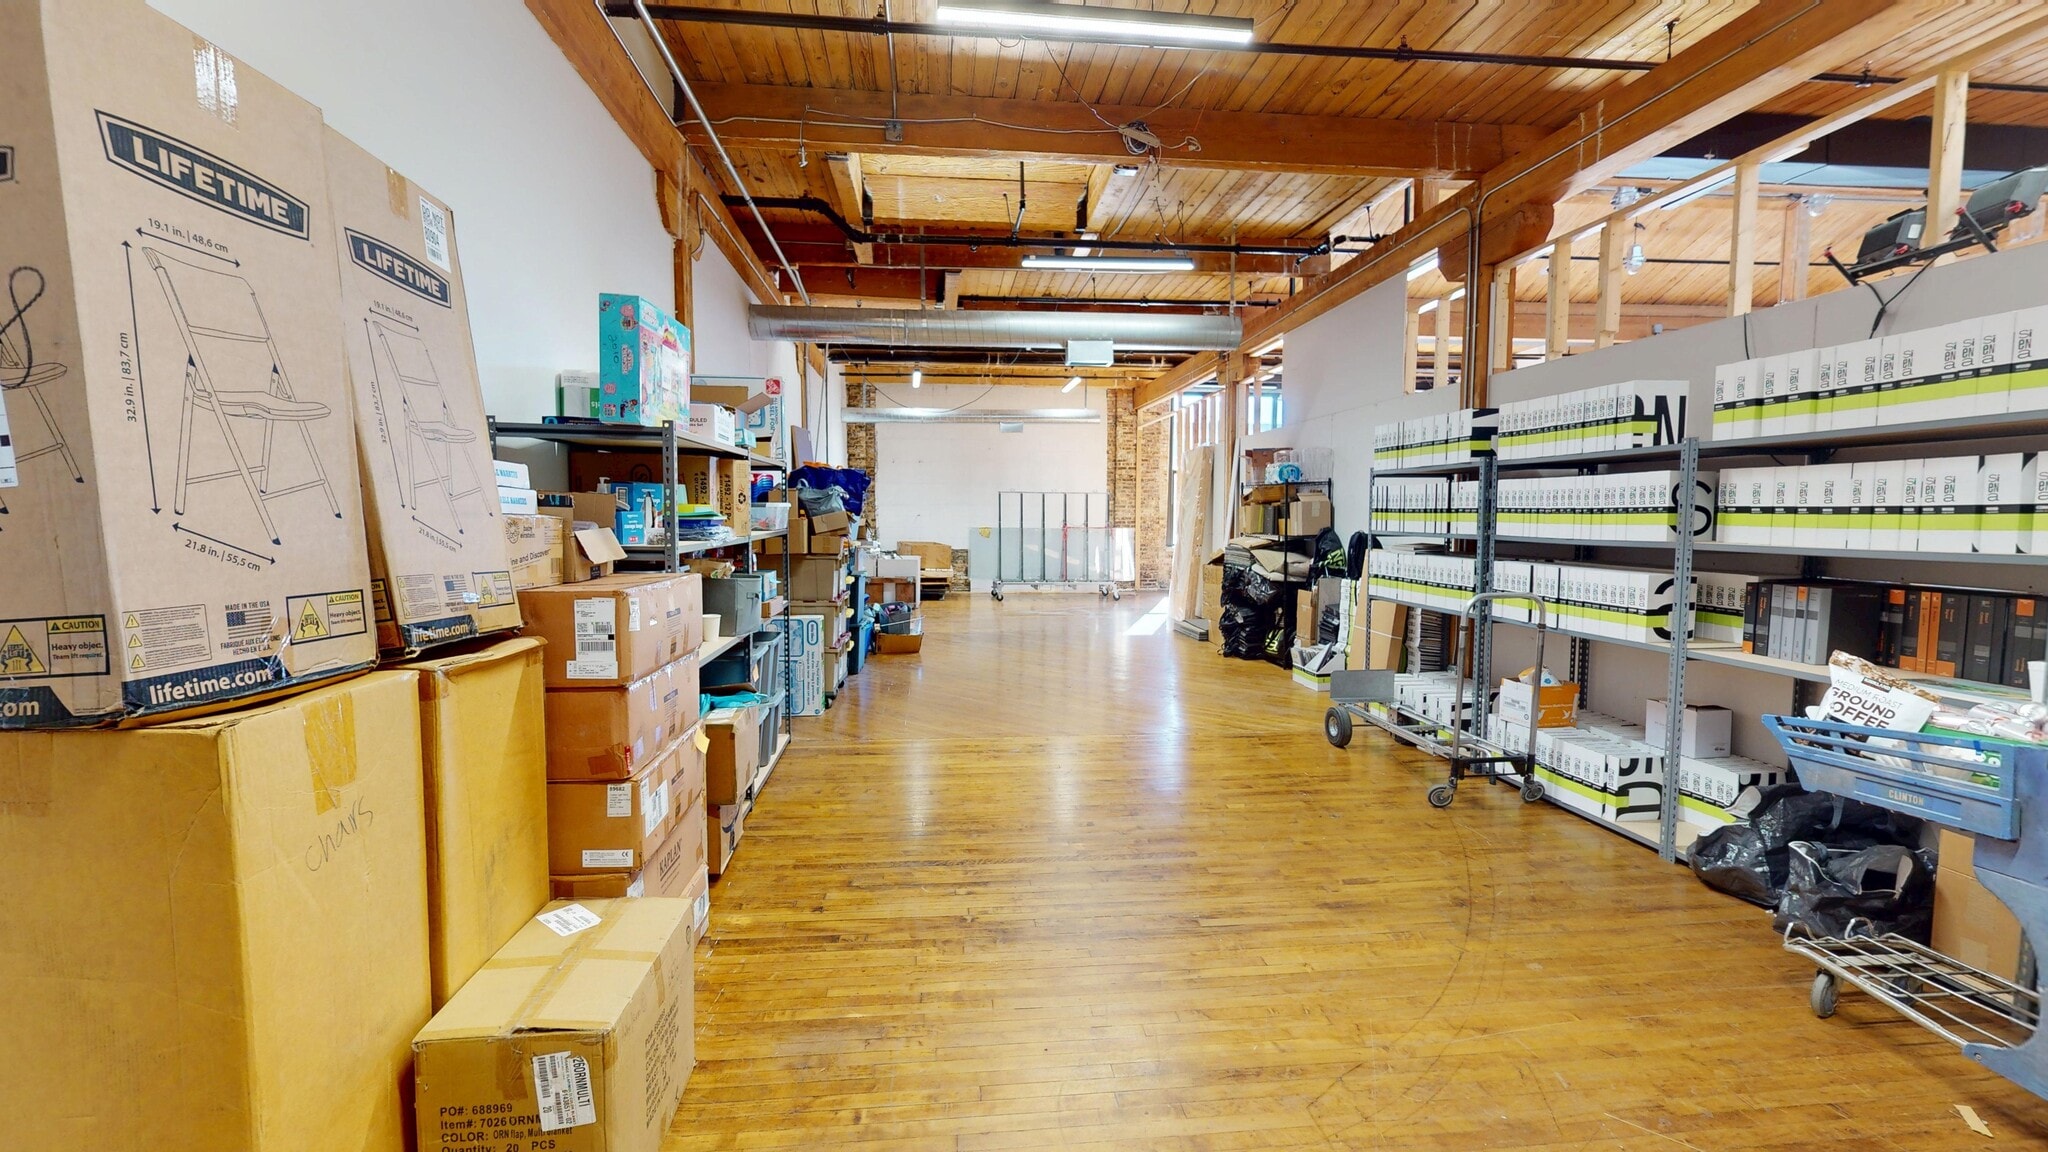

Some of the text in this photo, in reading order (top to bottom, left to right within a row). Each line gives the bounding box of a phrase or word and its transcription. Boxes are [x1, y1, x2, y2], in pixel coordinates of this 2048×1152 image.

[132, 135, 290, 225] LIFETIME
[148, 218, 169, 233] 19.1
[171, 225, 185, 239] in.
[192, 232, 213, 248] 48,6
[214, 243, 229, 253] cm
[362, 242, 441, 298] LIFETIME
[120, 332, 129, 349] cm
[120, 350, 132, 375] 83,7
[124, 383, 134, 397] in.
[125, 399, 137, 422] 32.9
[185, 539, 207, 553] 21.8
[208, 546, 220, 558] in.
[226, 554, 247, 567] 55,5
[247, 562, 261, 572] cm
[225, 603, 241, 611] MADE
[242, 602, 247, 610] IN
[335, 594, 359, 602] CAUTION
[62, 620, 100, 630] CAUTION
[52, 642, 77, 652] Heavy
[150, 668, 273, 705] lifetime.com
[1836, 680, 1872, 696] MEDIUM
[1874, 694, 1904, 709] ROAST
[1830, 702, 1890, 729] OFFEE
[1888, 790, 1925, 806] CLINTON
[659, 840, 681, 876] KAPLAN
[440, 1103, 513, 1117] PO#: 688969
[441, 1120, 477, 1130] Item#:
[442, 1132, 489, 1143] COLOR:
[494, 1130, 510, 1140] ORN
[506, 1144, 519, 1152] 20
[532, 1140, 556, 1151] PCS
